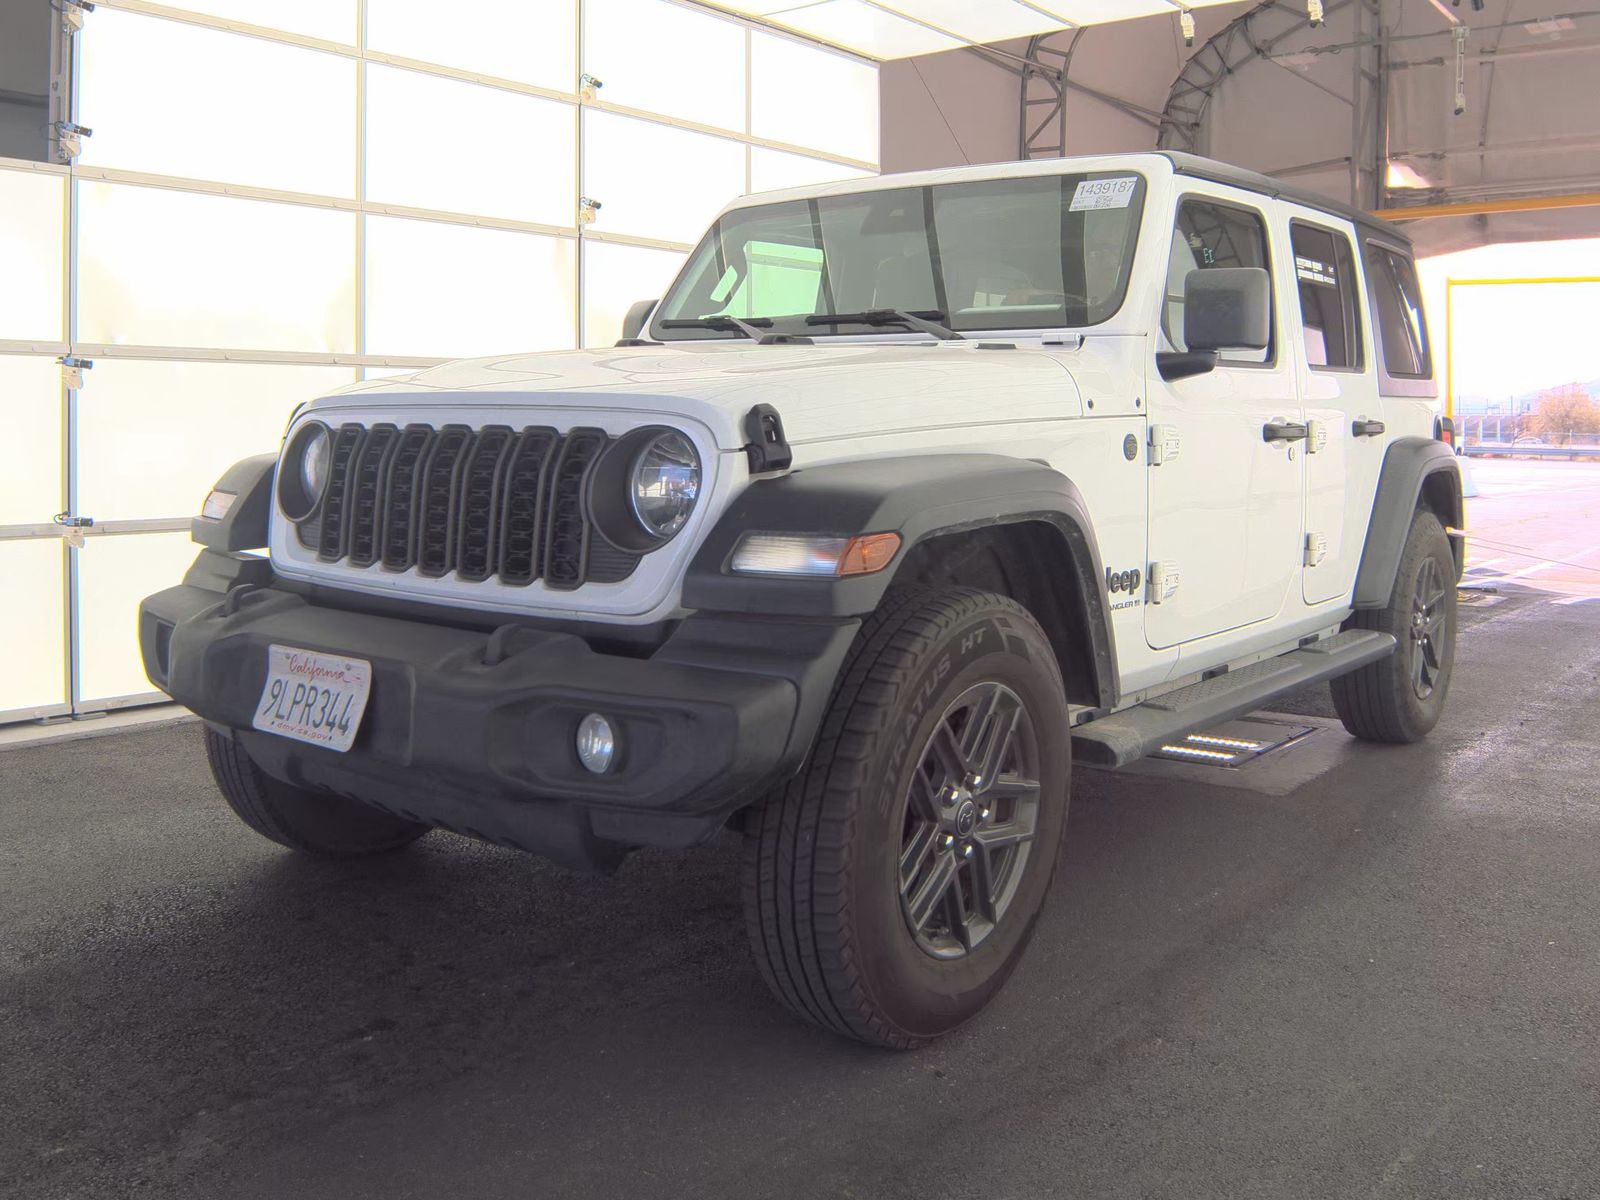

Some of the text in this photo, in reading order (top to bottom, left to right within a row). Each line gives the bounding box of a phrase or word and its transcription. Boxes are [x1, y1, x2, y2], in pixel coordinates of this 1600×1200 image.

[1080, 181, 1136, 196] 1439187
[1105, 566, 1141, 595] Jeep
[960, 627, 987, 654] HT
[289, 654, 352, 683] California
[262, 678, 354, 736] 9LPR344
